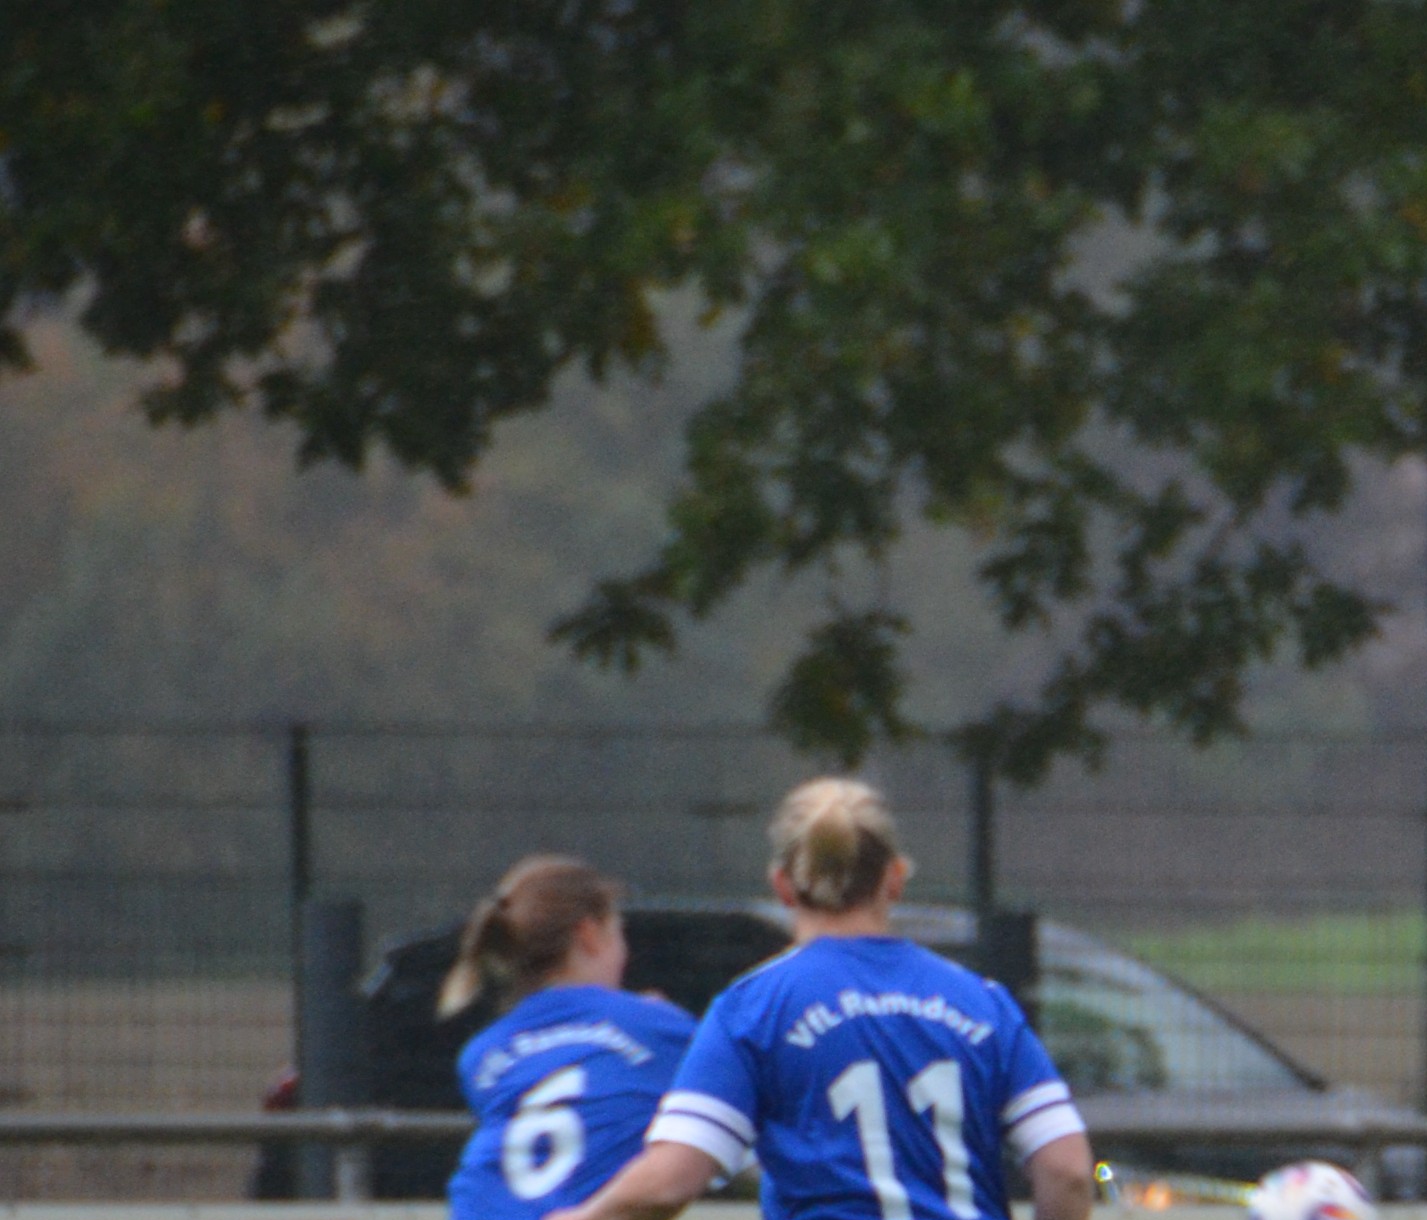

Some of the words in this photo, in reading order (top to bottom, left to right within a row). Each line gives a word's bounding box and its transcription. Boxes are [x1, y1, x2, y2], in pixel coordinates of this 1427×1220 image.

[785, 1003, 842, 1047] VfL
[840, 990, 992, 1044] Ramsdorf
[503, 1064, 583, 1200] 6
